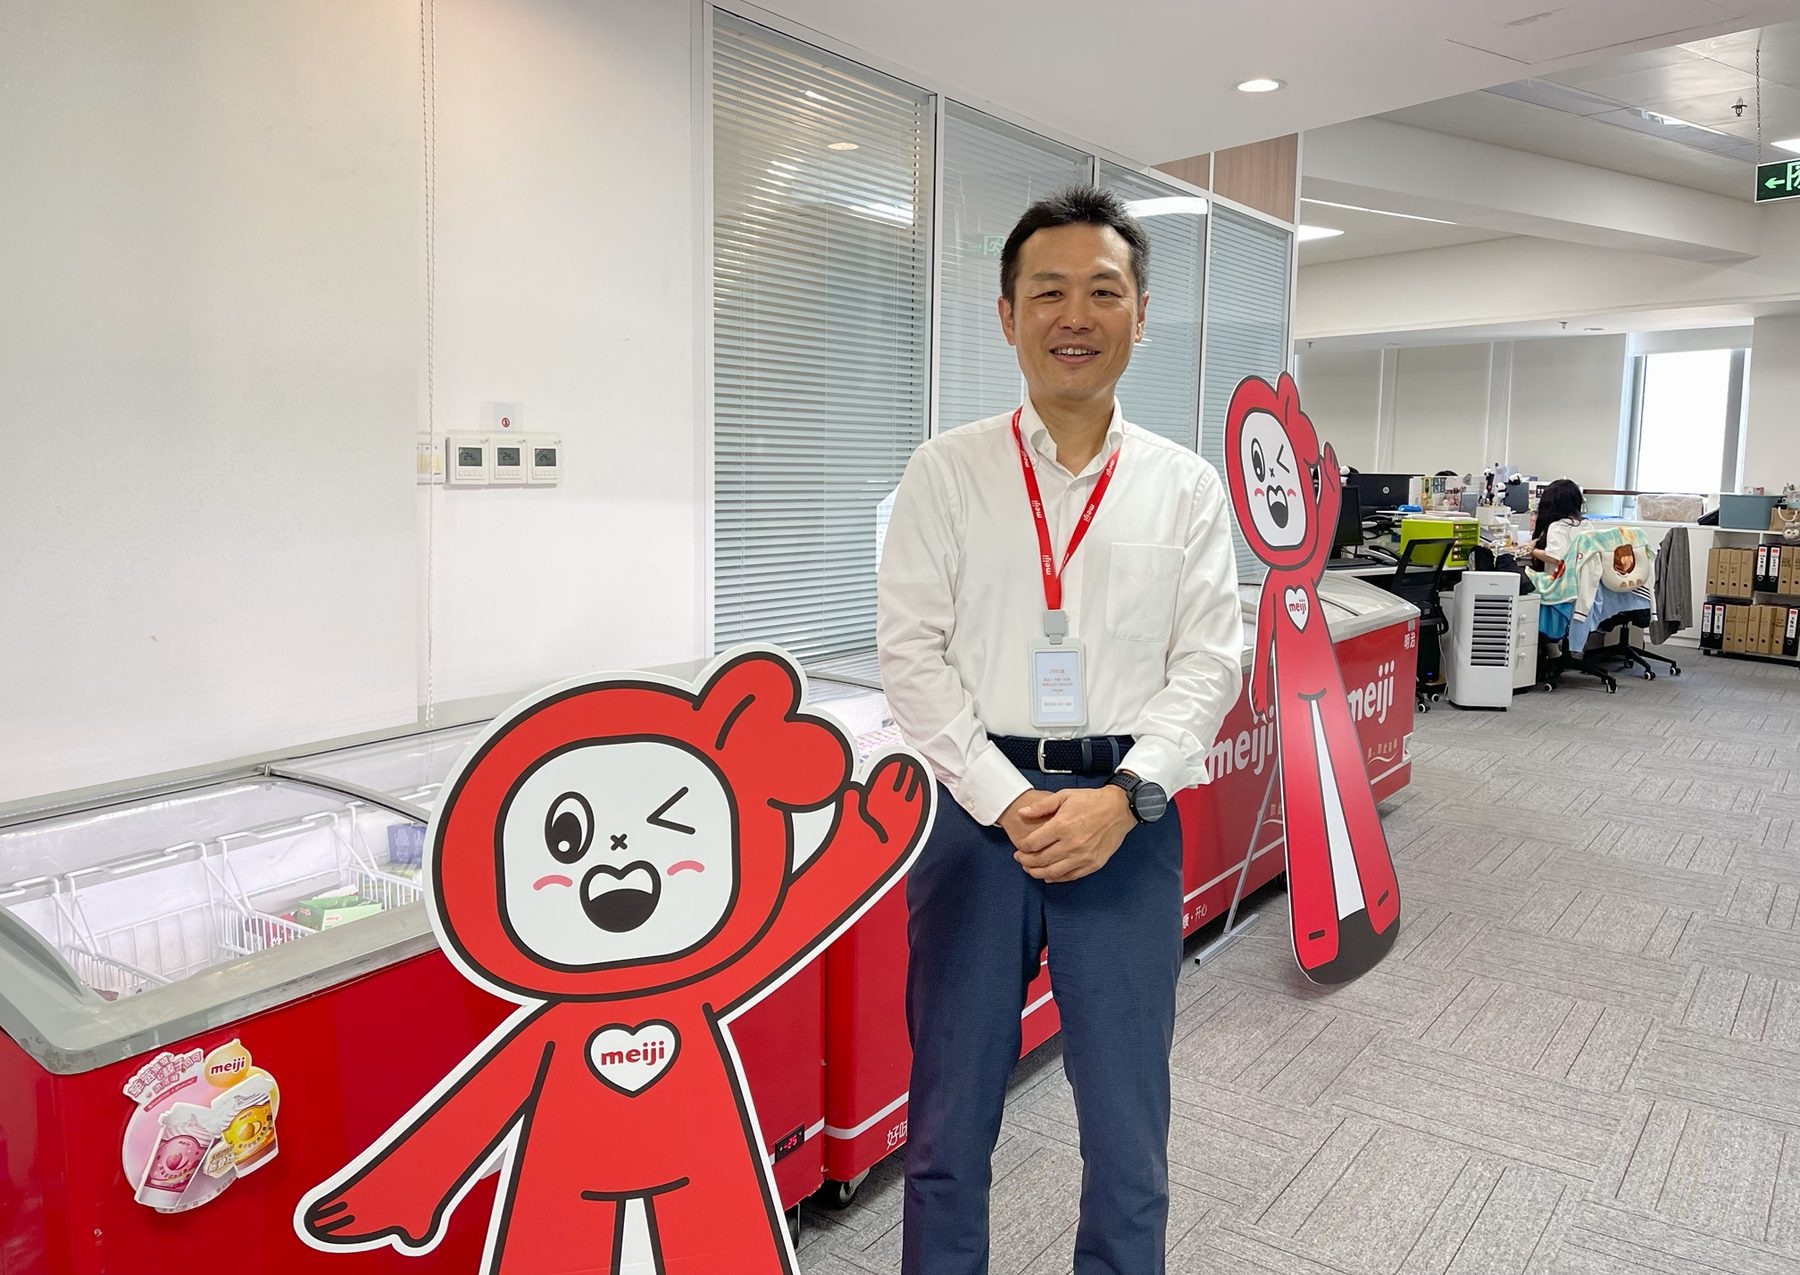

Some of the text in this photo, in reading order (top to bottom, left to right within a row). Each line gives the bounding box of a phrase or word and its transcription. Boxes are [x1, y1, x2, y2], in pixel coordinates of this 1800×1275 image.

[1031, 500, 1043, 519] meiji
[1083, 503, 1095, 523] meiji
[1042, 554, 1052, 576] meiji
[1289, 599, 1306, 615] meiji
[1347, 660, 1395, 724] meiji
[1204, 704, 1274, 783] meiji
[601, 1040, 664, 1066] meiji
[210, 1057, 246, 1075] meiji
